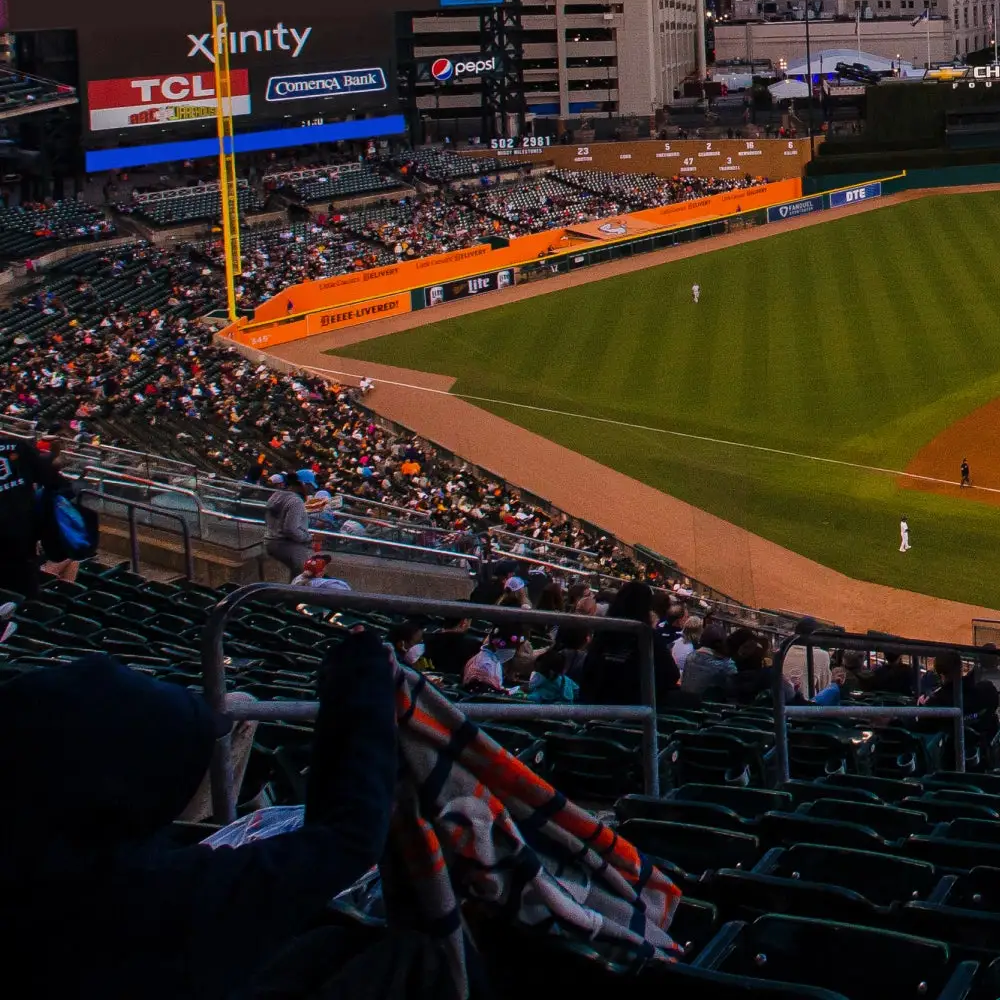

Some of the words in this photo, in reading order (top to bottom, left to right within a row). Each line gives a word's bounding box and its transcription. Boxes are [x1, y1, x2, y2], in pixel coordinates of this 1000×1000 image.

[186, 22, 313, 64] xfinity
[455, 57, 496, 76] pepsi
[343, 73, 377, 87] Bank
[131, 75, 215, 102] TCL
[491, 138, 515, 149] 502
[522, 136, 551, 147] 2981
[664, 143, 671, 151] 5
[577, 147, 590, 155] 23
[726, 157, 733, 165] 3
[845, 188, 867, 202] DTE
[788, 200, 813, 212] FANDUEL
[363, 267, 399, 282] DELIVERY
[468, 277, 490, 294] Lite
